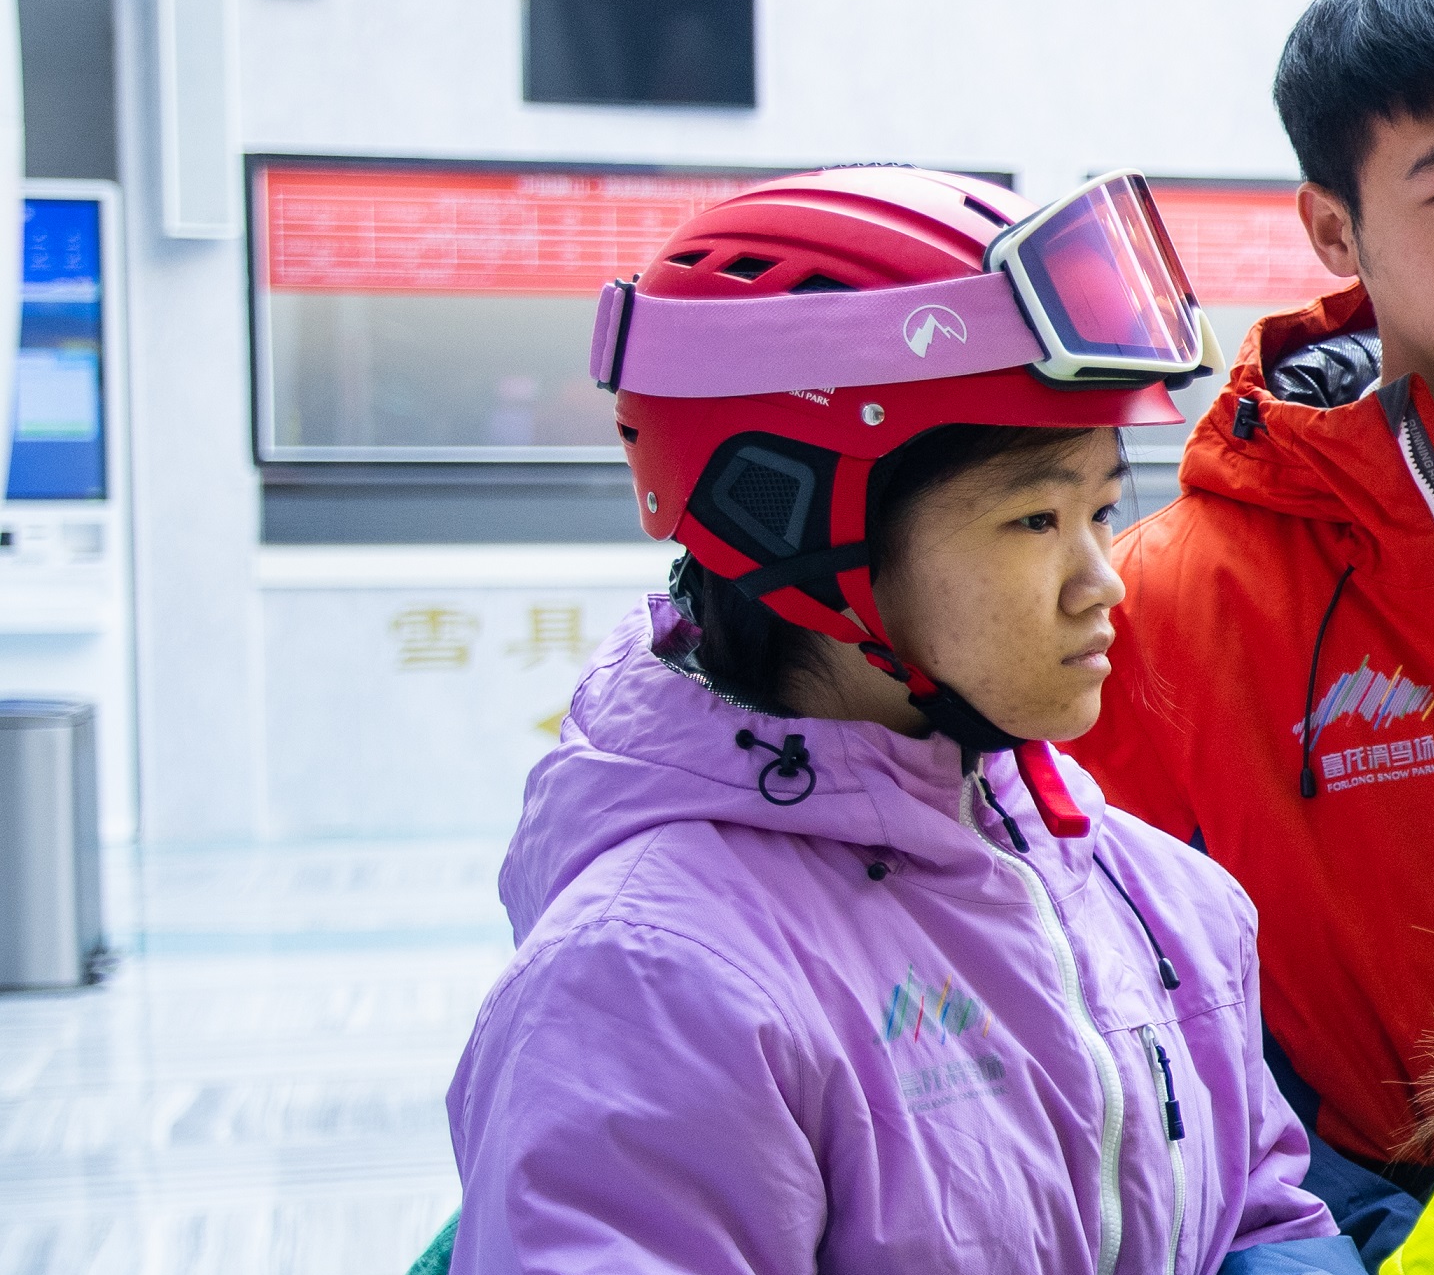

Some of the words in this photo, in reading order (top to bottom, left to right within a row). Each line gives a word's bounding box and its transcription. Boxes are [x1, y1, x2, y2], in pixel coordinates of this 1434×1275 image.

[806, 392, 830, 407] PARK
[1408, 417, 1432, 470] RUNNING
[1327, 774, 1375, 793] FORLONG
[1377, 769, 1410, 783] SNOW
